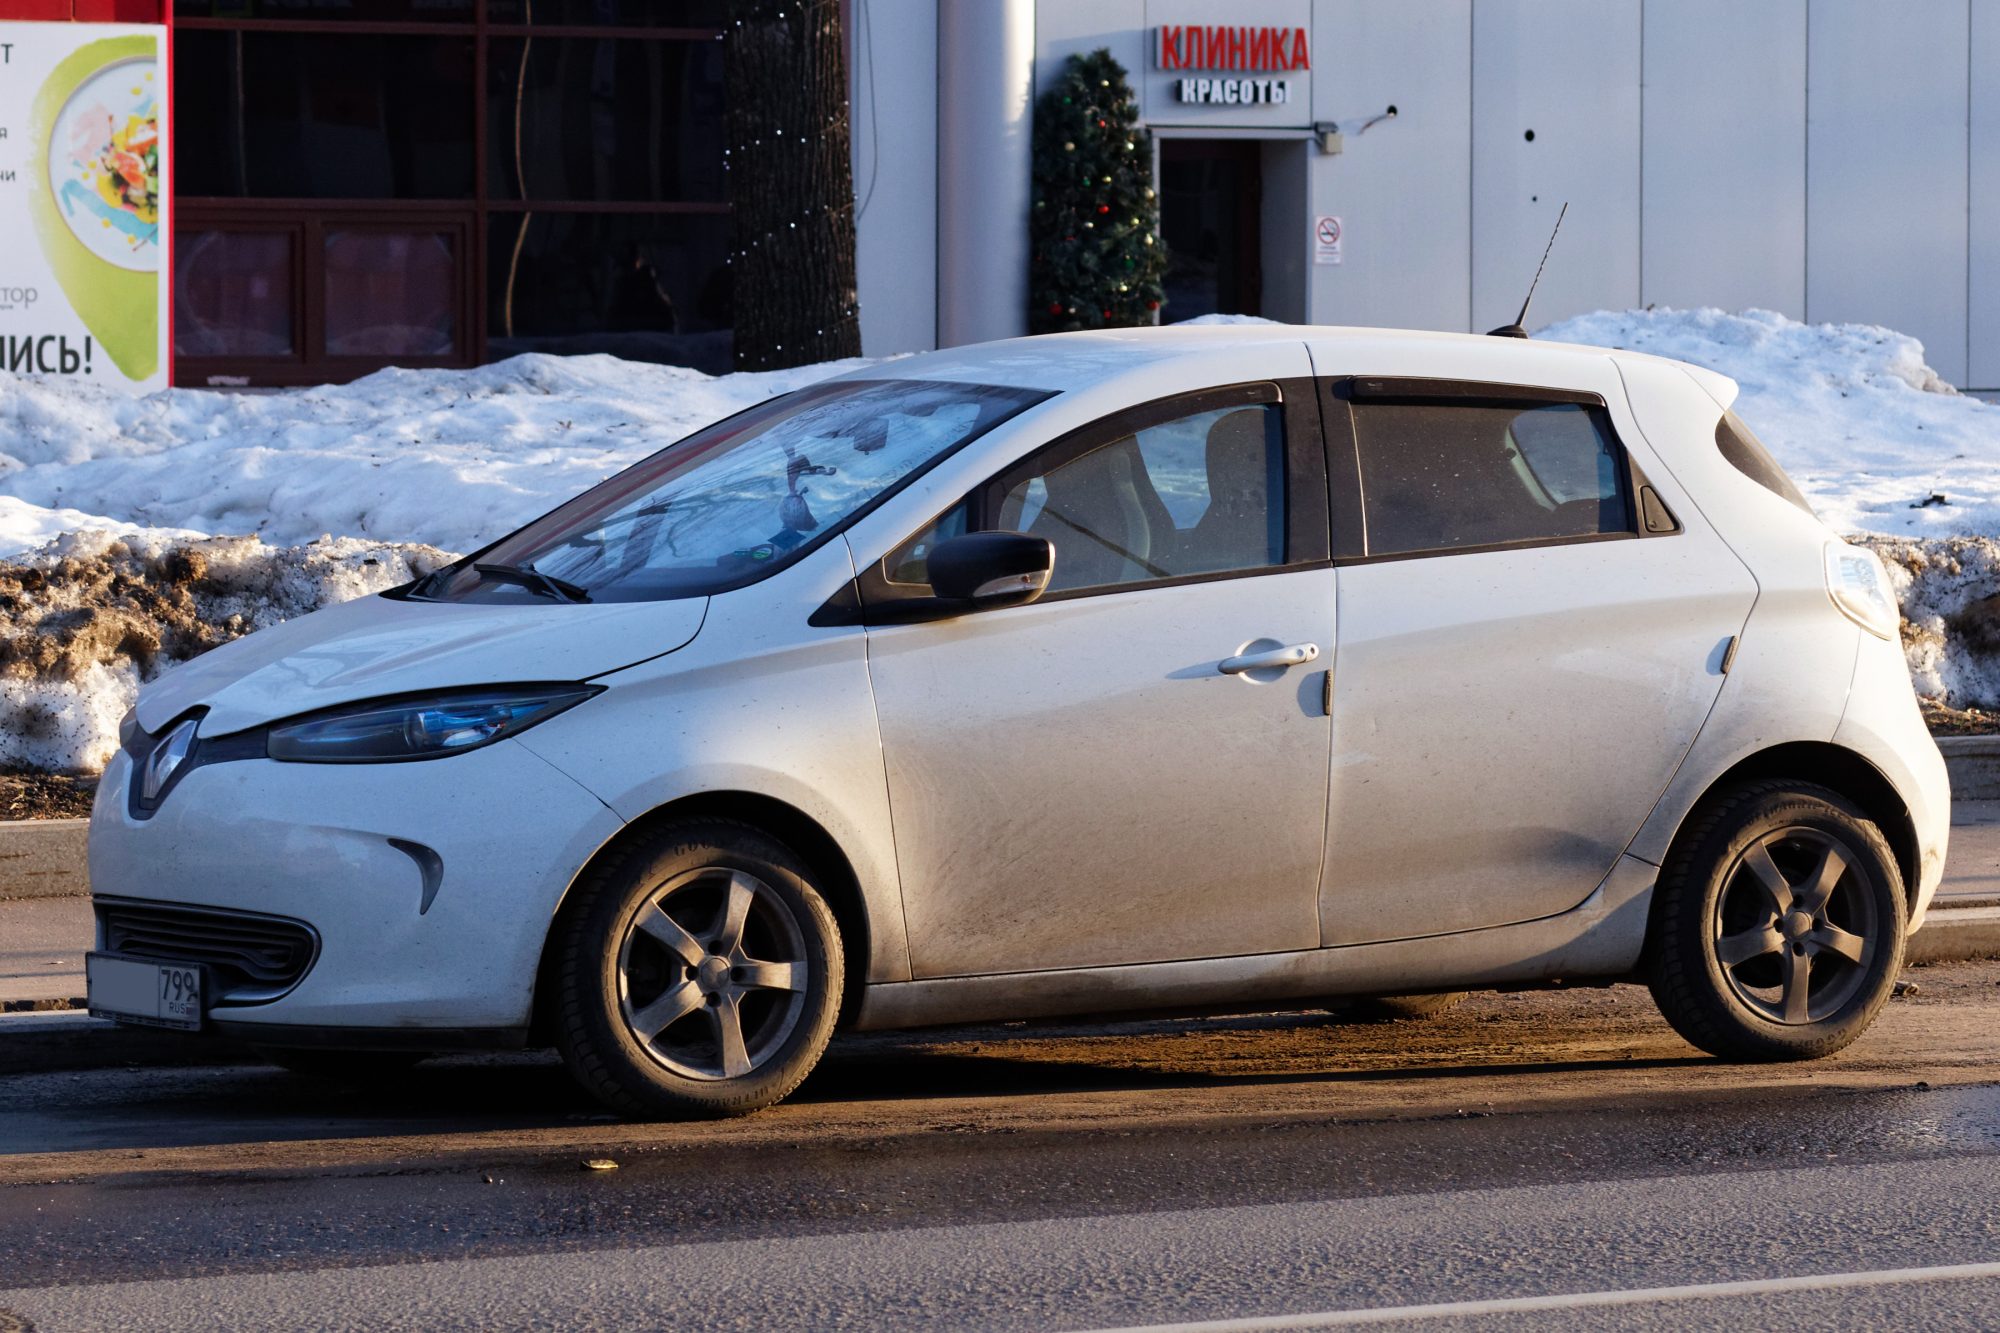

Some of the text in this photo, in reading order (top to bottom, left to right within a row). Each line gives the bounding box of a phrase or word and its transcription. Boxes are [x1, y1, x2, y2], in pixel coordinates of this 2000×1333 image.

[1160, 25, 1310, 71] КЛИНИКА
[1180, 79, 1292, 104] КРАСОТЫ
[161, 969, 196, 1002] 799
[169, 1002, 186, 1014] RUS
